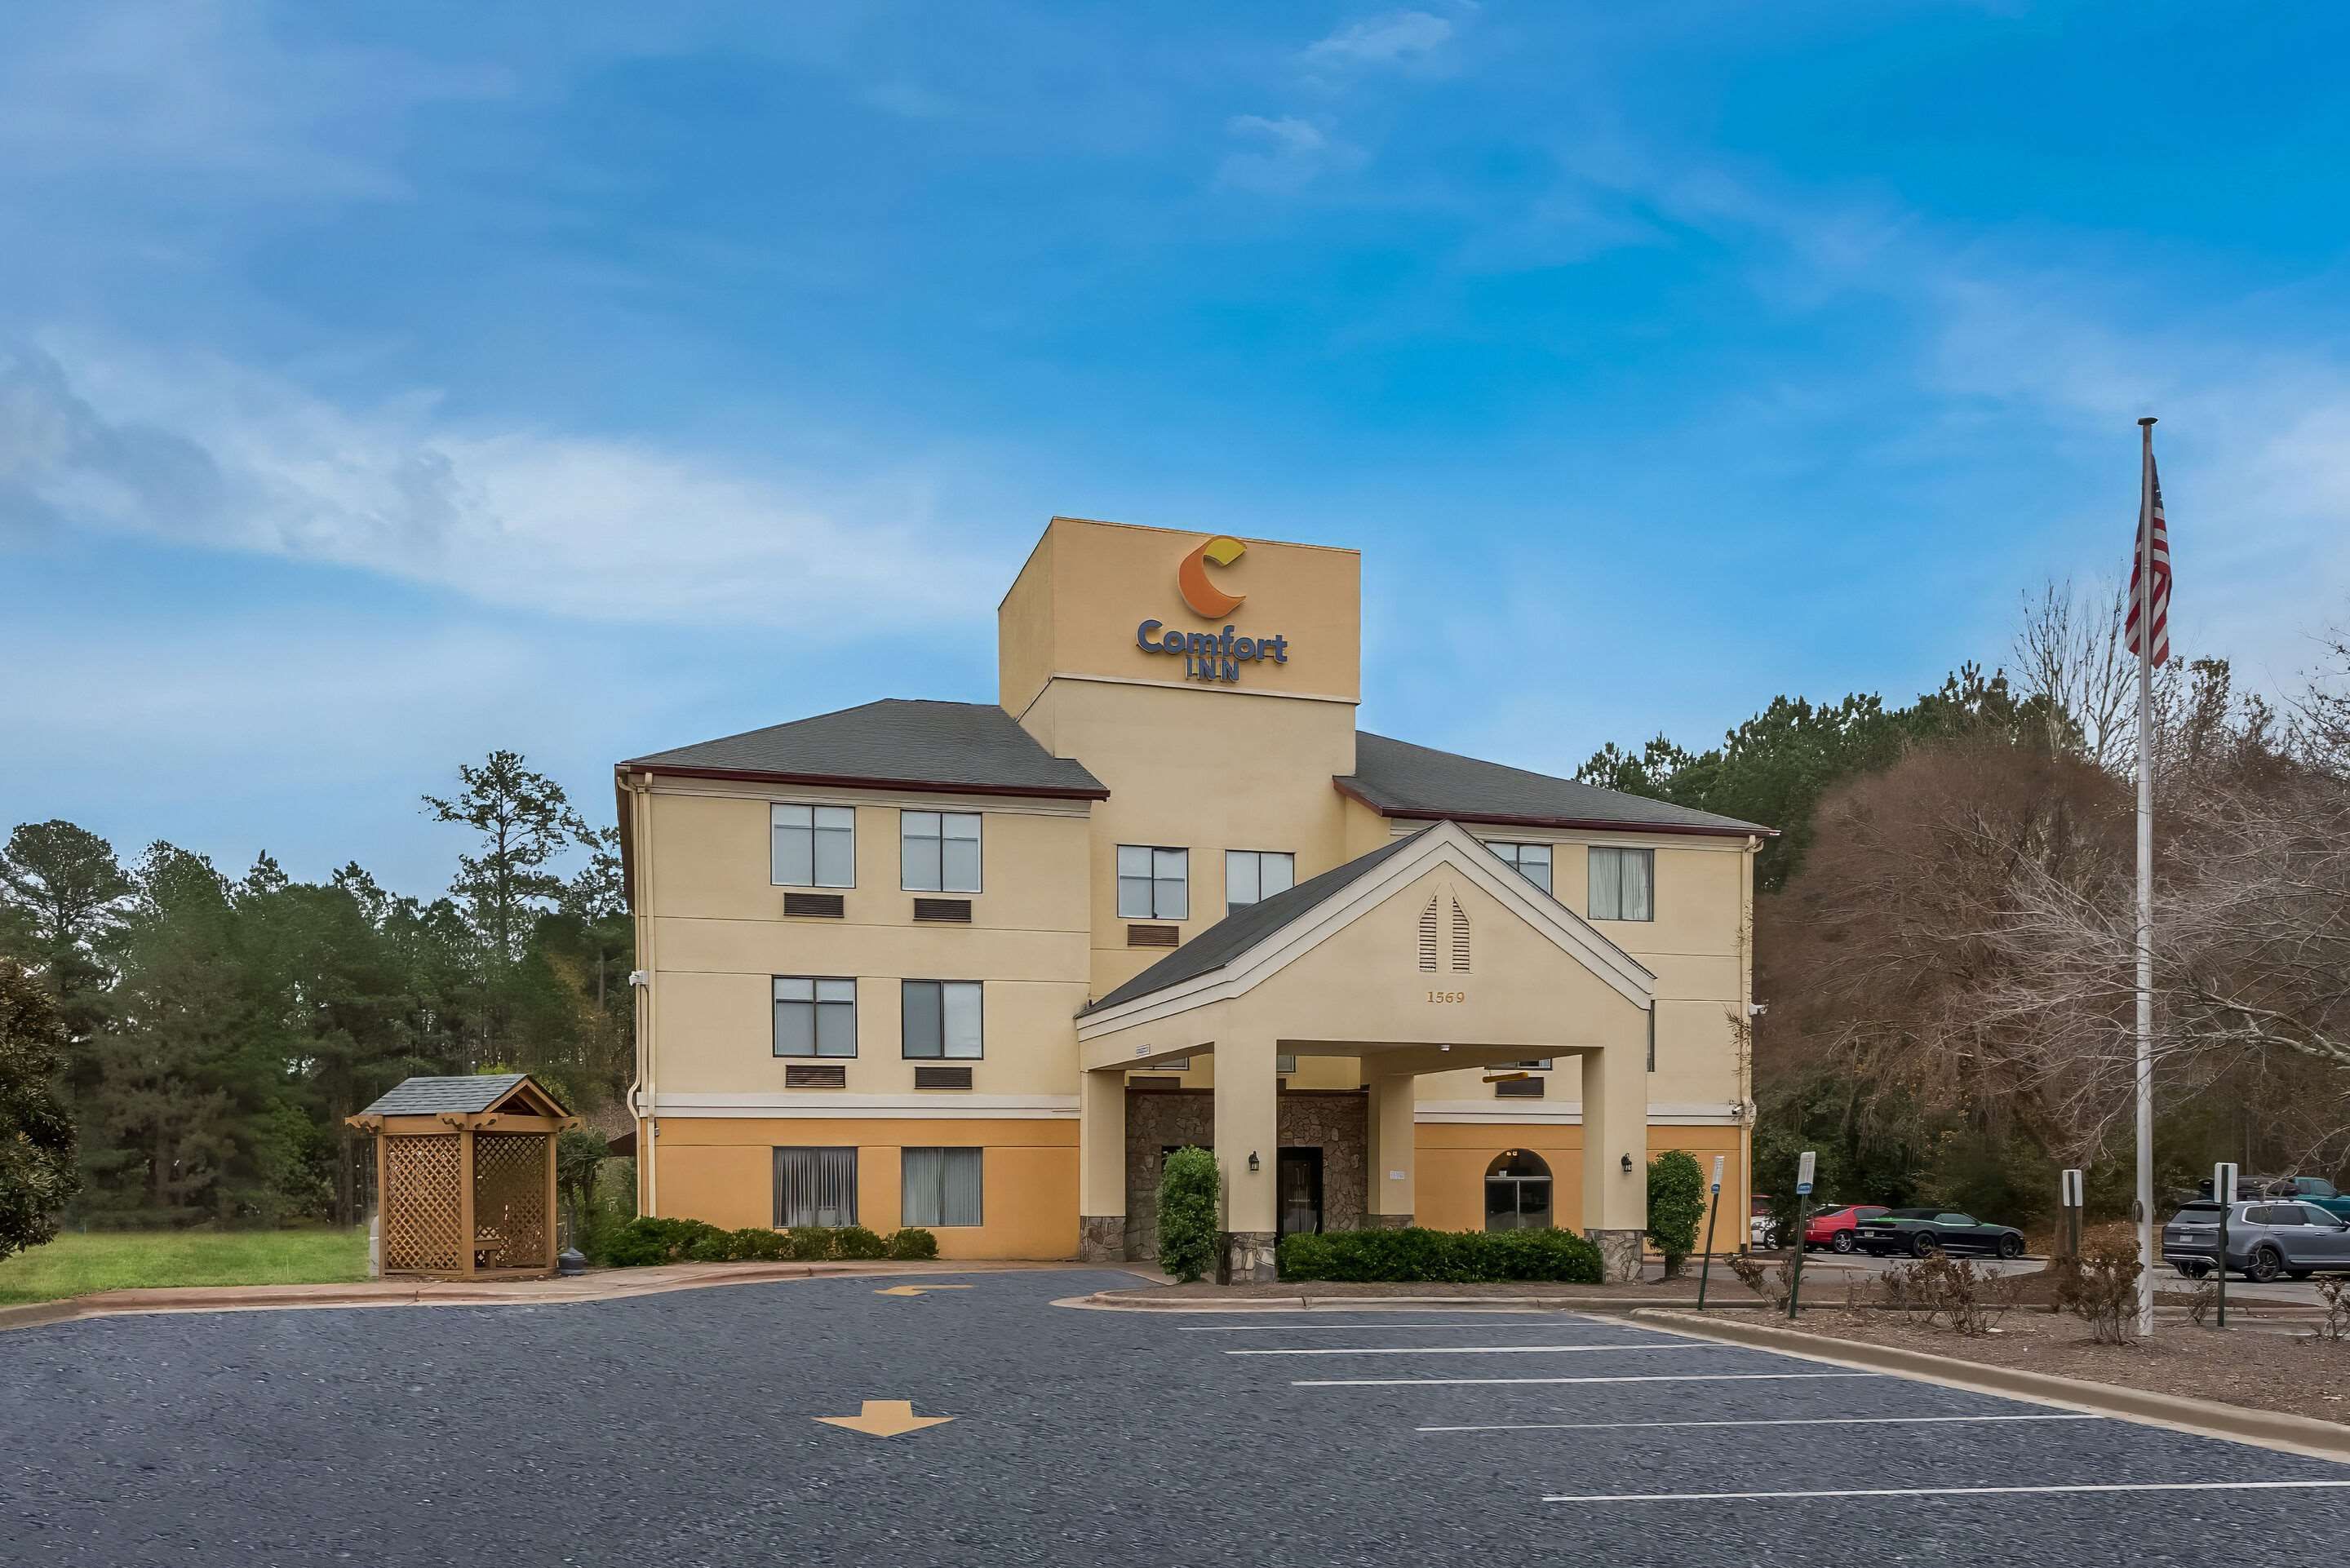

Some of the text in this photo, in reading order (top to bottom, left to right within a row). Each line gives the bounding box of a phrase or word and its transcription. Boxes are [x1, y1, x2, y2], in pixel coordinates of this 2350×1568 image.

[1137, 618, 1288, 664] Comfort
[1185, 656, 1240, 683] INN
[1426, 991, 1465, 1003] 1569
